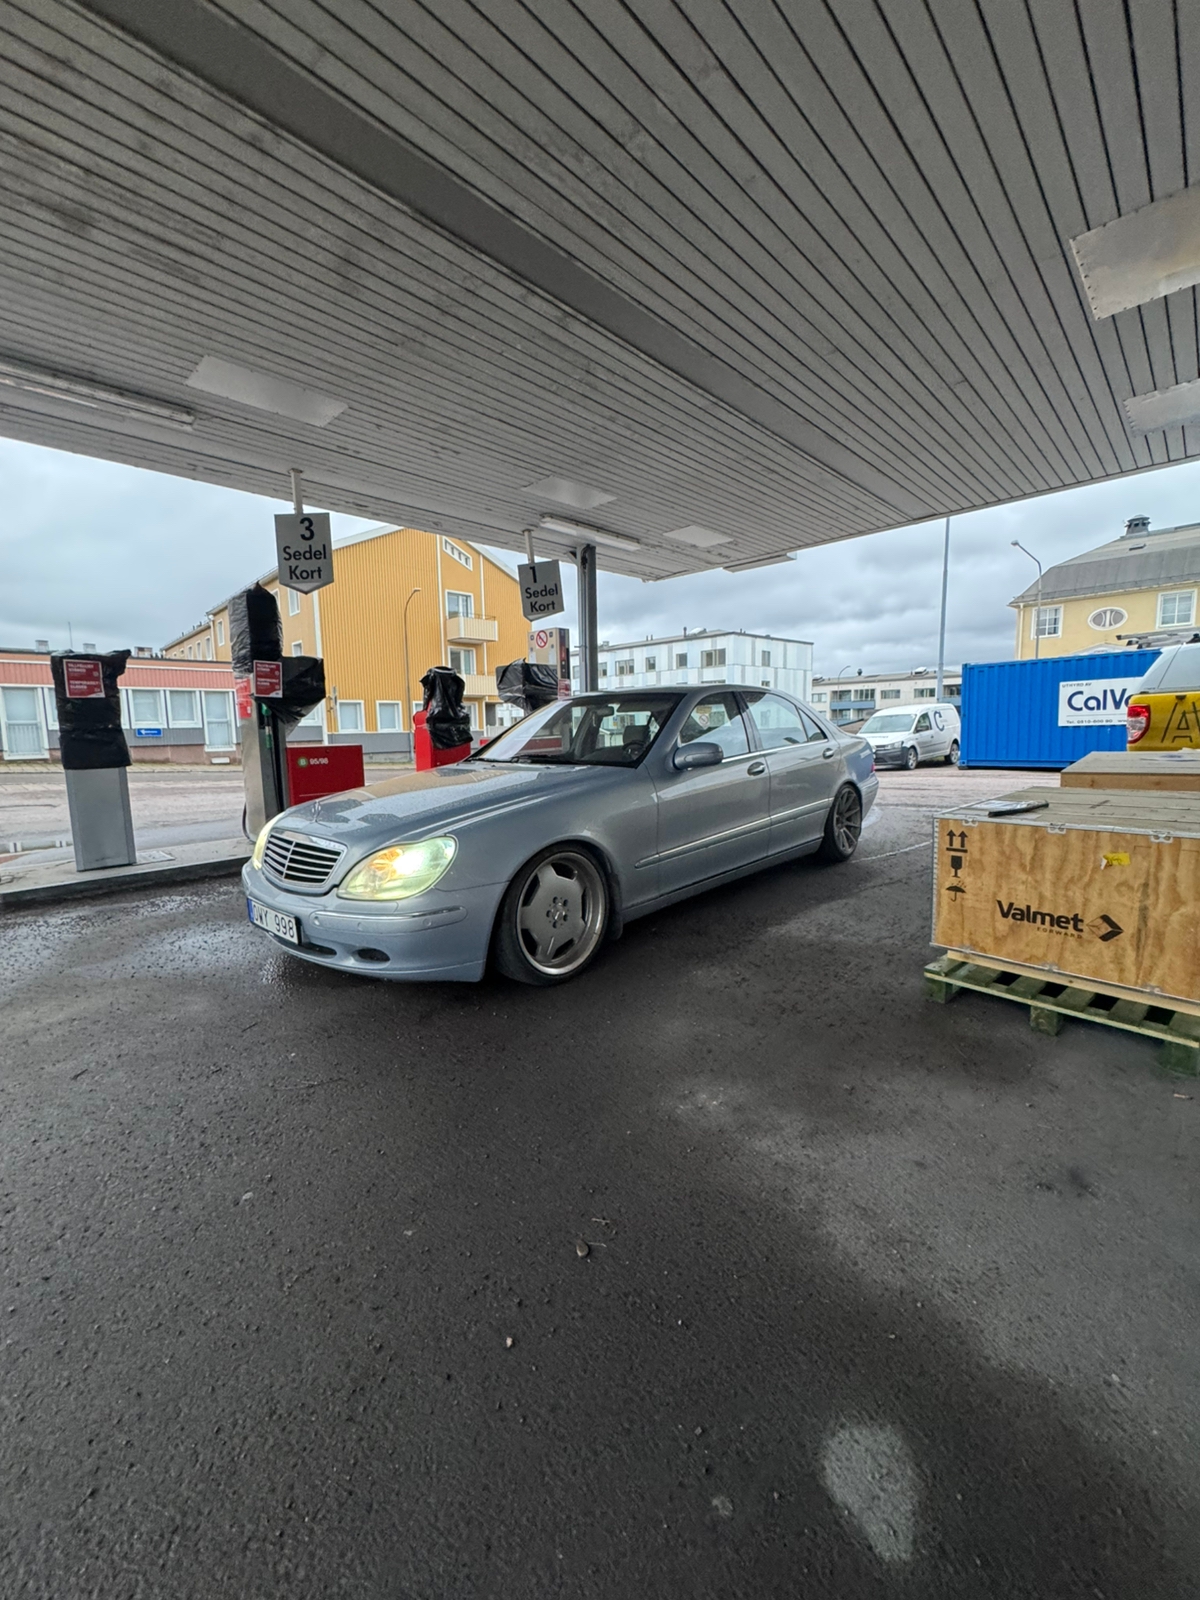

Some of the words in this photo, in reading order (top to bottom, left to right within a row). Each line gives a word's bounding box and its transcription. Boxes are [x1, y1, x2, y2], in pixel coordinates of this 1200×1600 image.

[299, 516, 315, 541] 3
[282, 543, 327, 561] Sedel
[288, 564, 323, 580] Kort
[529, 565, 537, 584] 1
[524, 583, 559, 599] Sedel
[530, 600, 556, 613] Kort
[996, 899, 1084, 933] Valmet
[274, 914, 295, 939] 998
[1036, 926, 1083, 940] FORWARD
